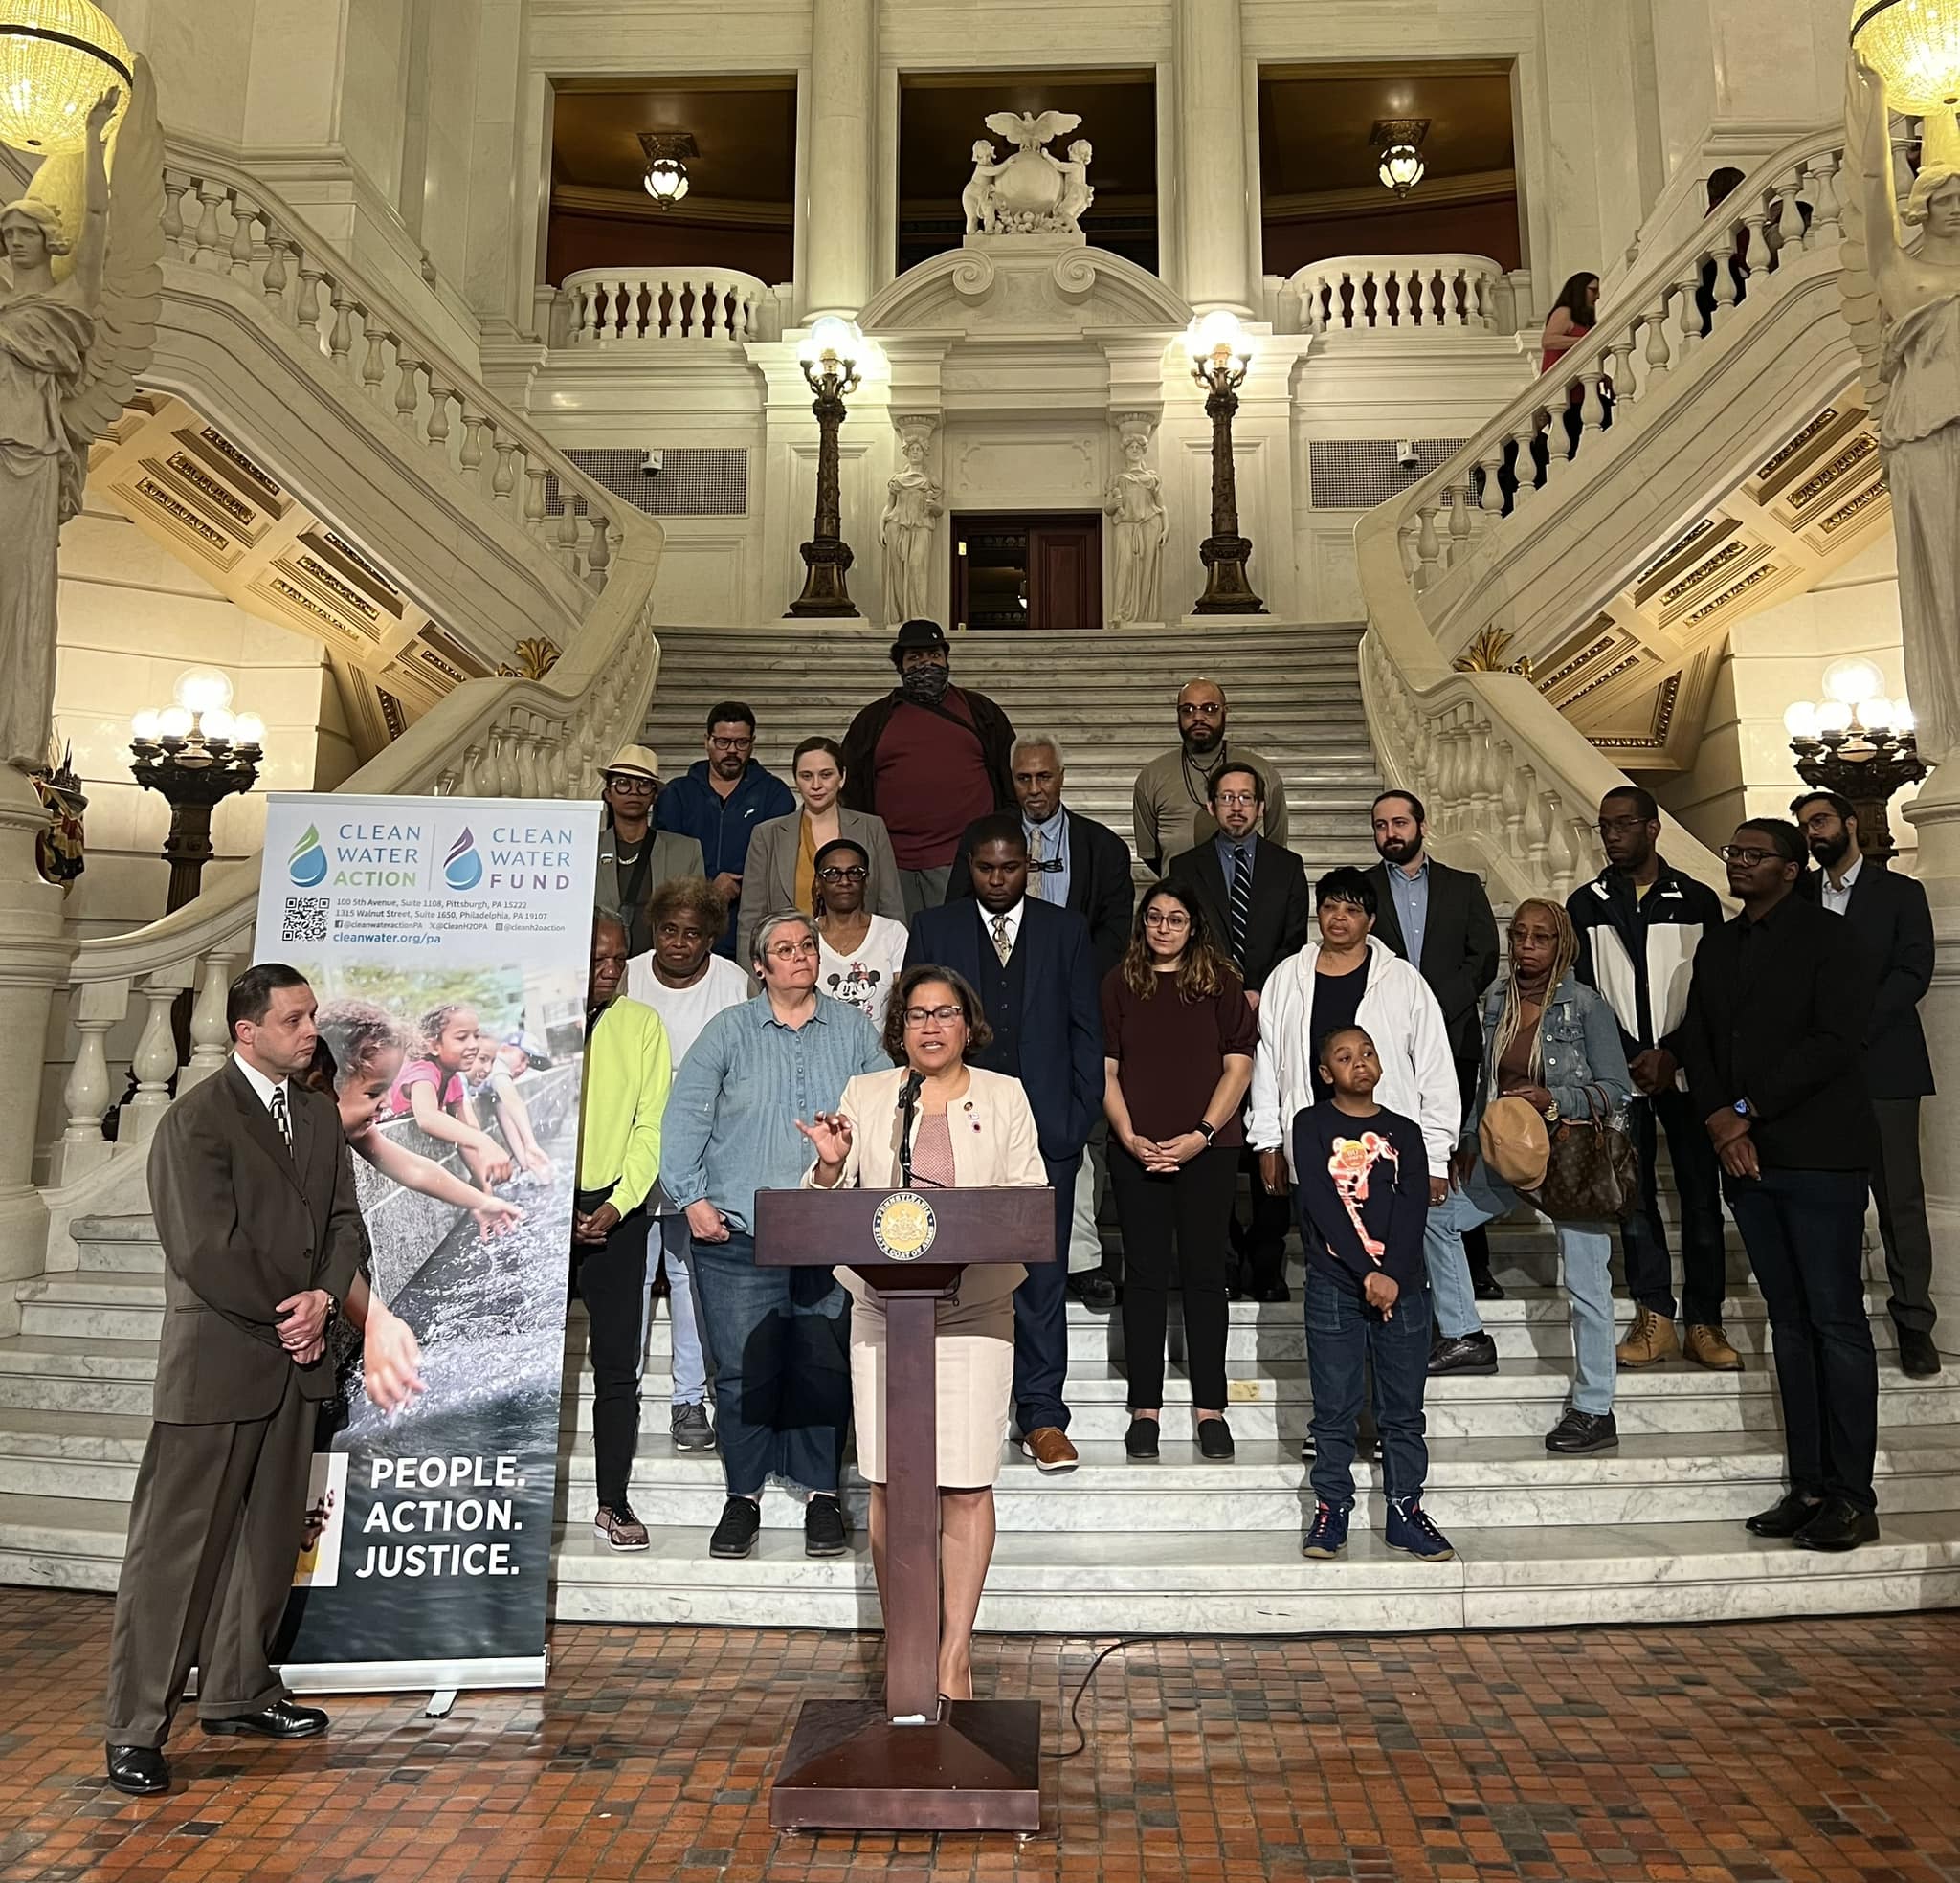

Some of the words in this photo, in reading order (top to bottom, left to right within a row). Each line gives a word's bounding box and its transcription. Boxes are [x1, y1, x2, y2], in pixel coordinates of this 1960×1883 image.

[339, 824, 421, 841] CLEAN
[492, 828, 572, 844] CLEAN
[337, 847, 418, 864] WATER
[490, 851, 570, 867] WATER
[333, 871, 416, 887] ACTION
[490, 874, 570, 890] FUND
[368, 899, 399, 908] Avenue,
[424, 899, 444, 908] 1108,
[446, 900, 490, 910] Pittsburgh,
[386, 910, 412, 919] Street,
[437, 911, 457, 919] 1650,
[459, 911, 511, 920] Philadelphia,
[333, 932, 441, 945] cleanwater.org/pa
[877, 1194, 931, 1218] PENNSYLVANIA
[875, 1227, 890, 1252] STATE
[890, 1249, 910, 1258] COAT
[370, 1455, 526, 1489] PEOPLE.
[363, 1498, 523, 1533] ACTION.
[355, 1543, 520, 1579] JUSTICE.
